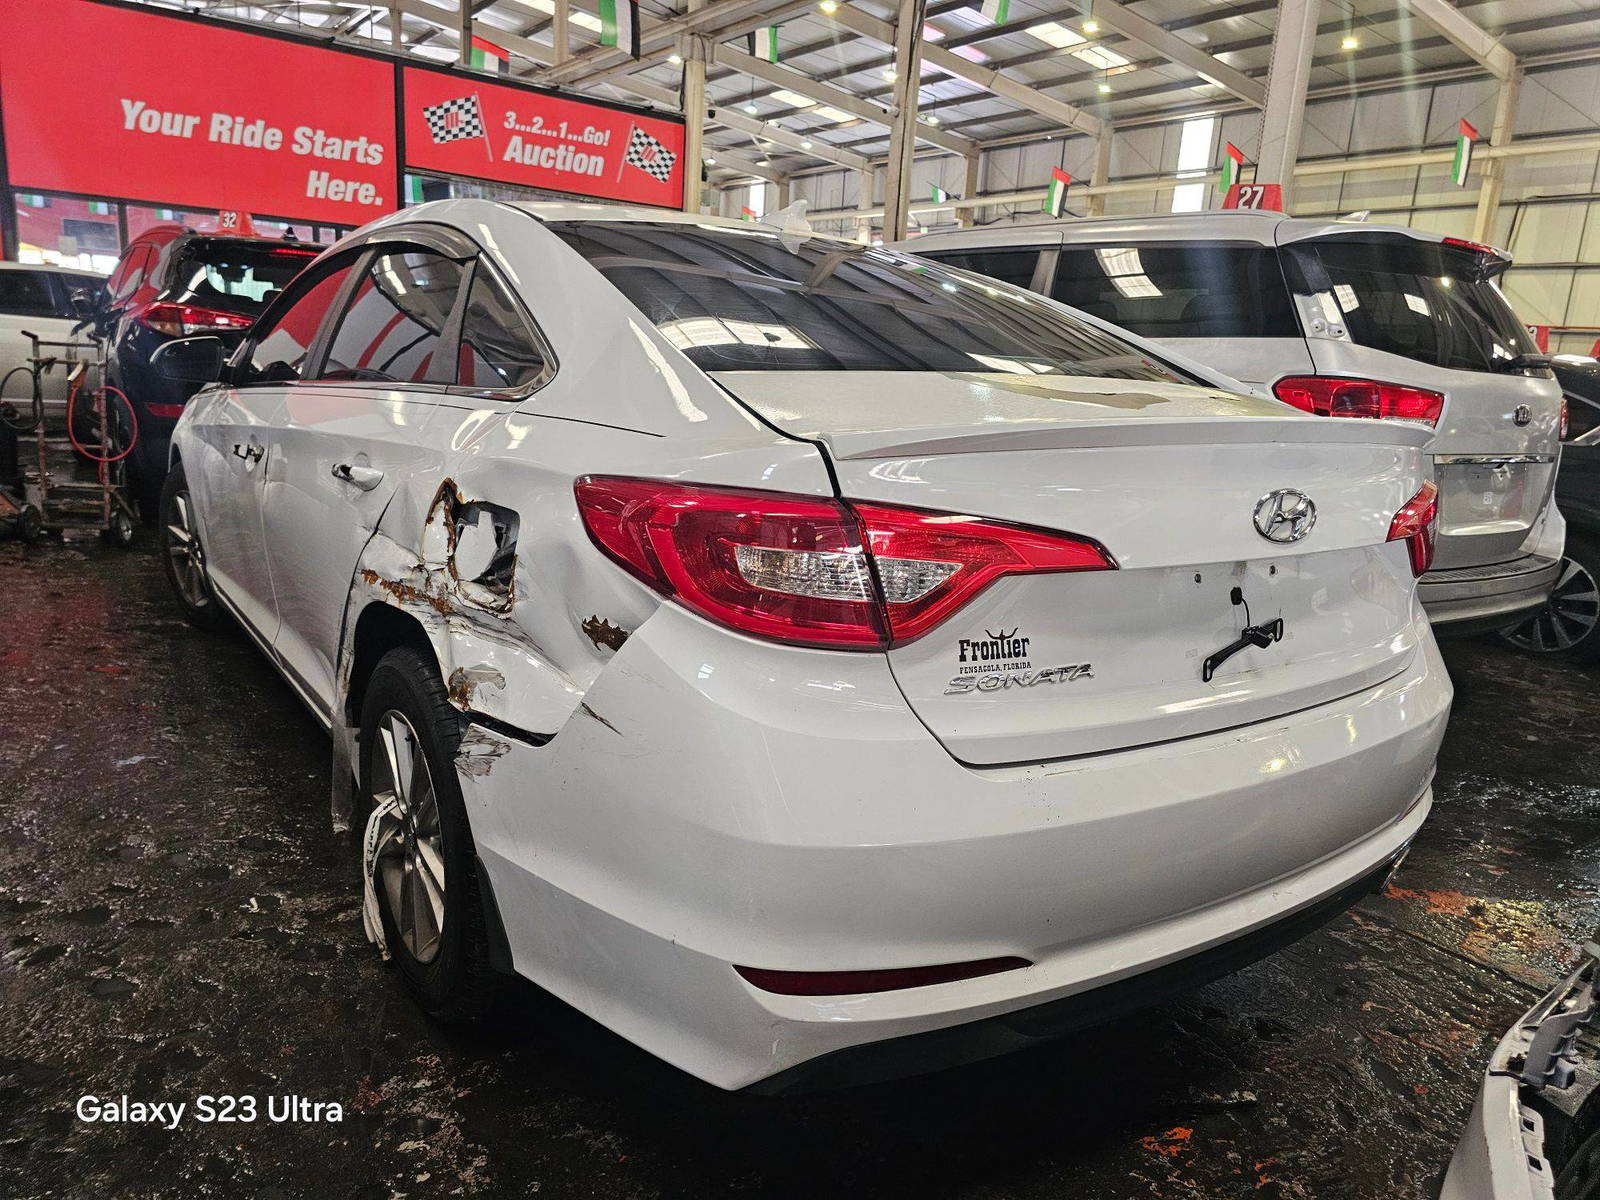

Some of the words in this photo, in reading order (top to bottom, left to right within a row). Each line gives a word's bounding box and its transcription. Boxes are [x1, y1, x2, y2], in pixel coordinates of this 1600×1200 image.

[121, 98, 200, 138] Your
[208, 112, 283, 151] Ride
[291, 126, 384, 166] Starts
[502, 135, 605, 177] Auction
[306, 169, 383, 206] Here.
[1238, 186, 1265, 209] 27
[223, 211, 237, 228] 32
[958, 637, 1030, 662] Frontier
[943, 663, 1094, 695] SONATA
[1003, 662, 1032, 671] FLORIDA
